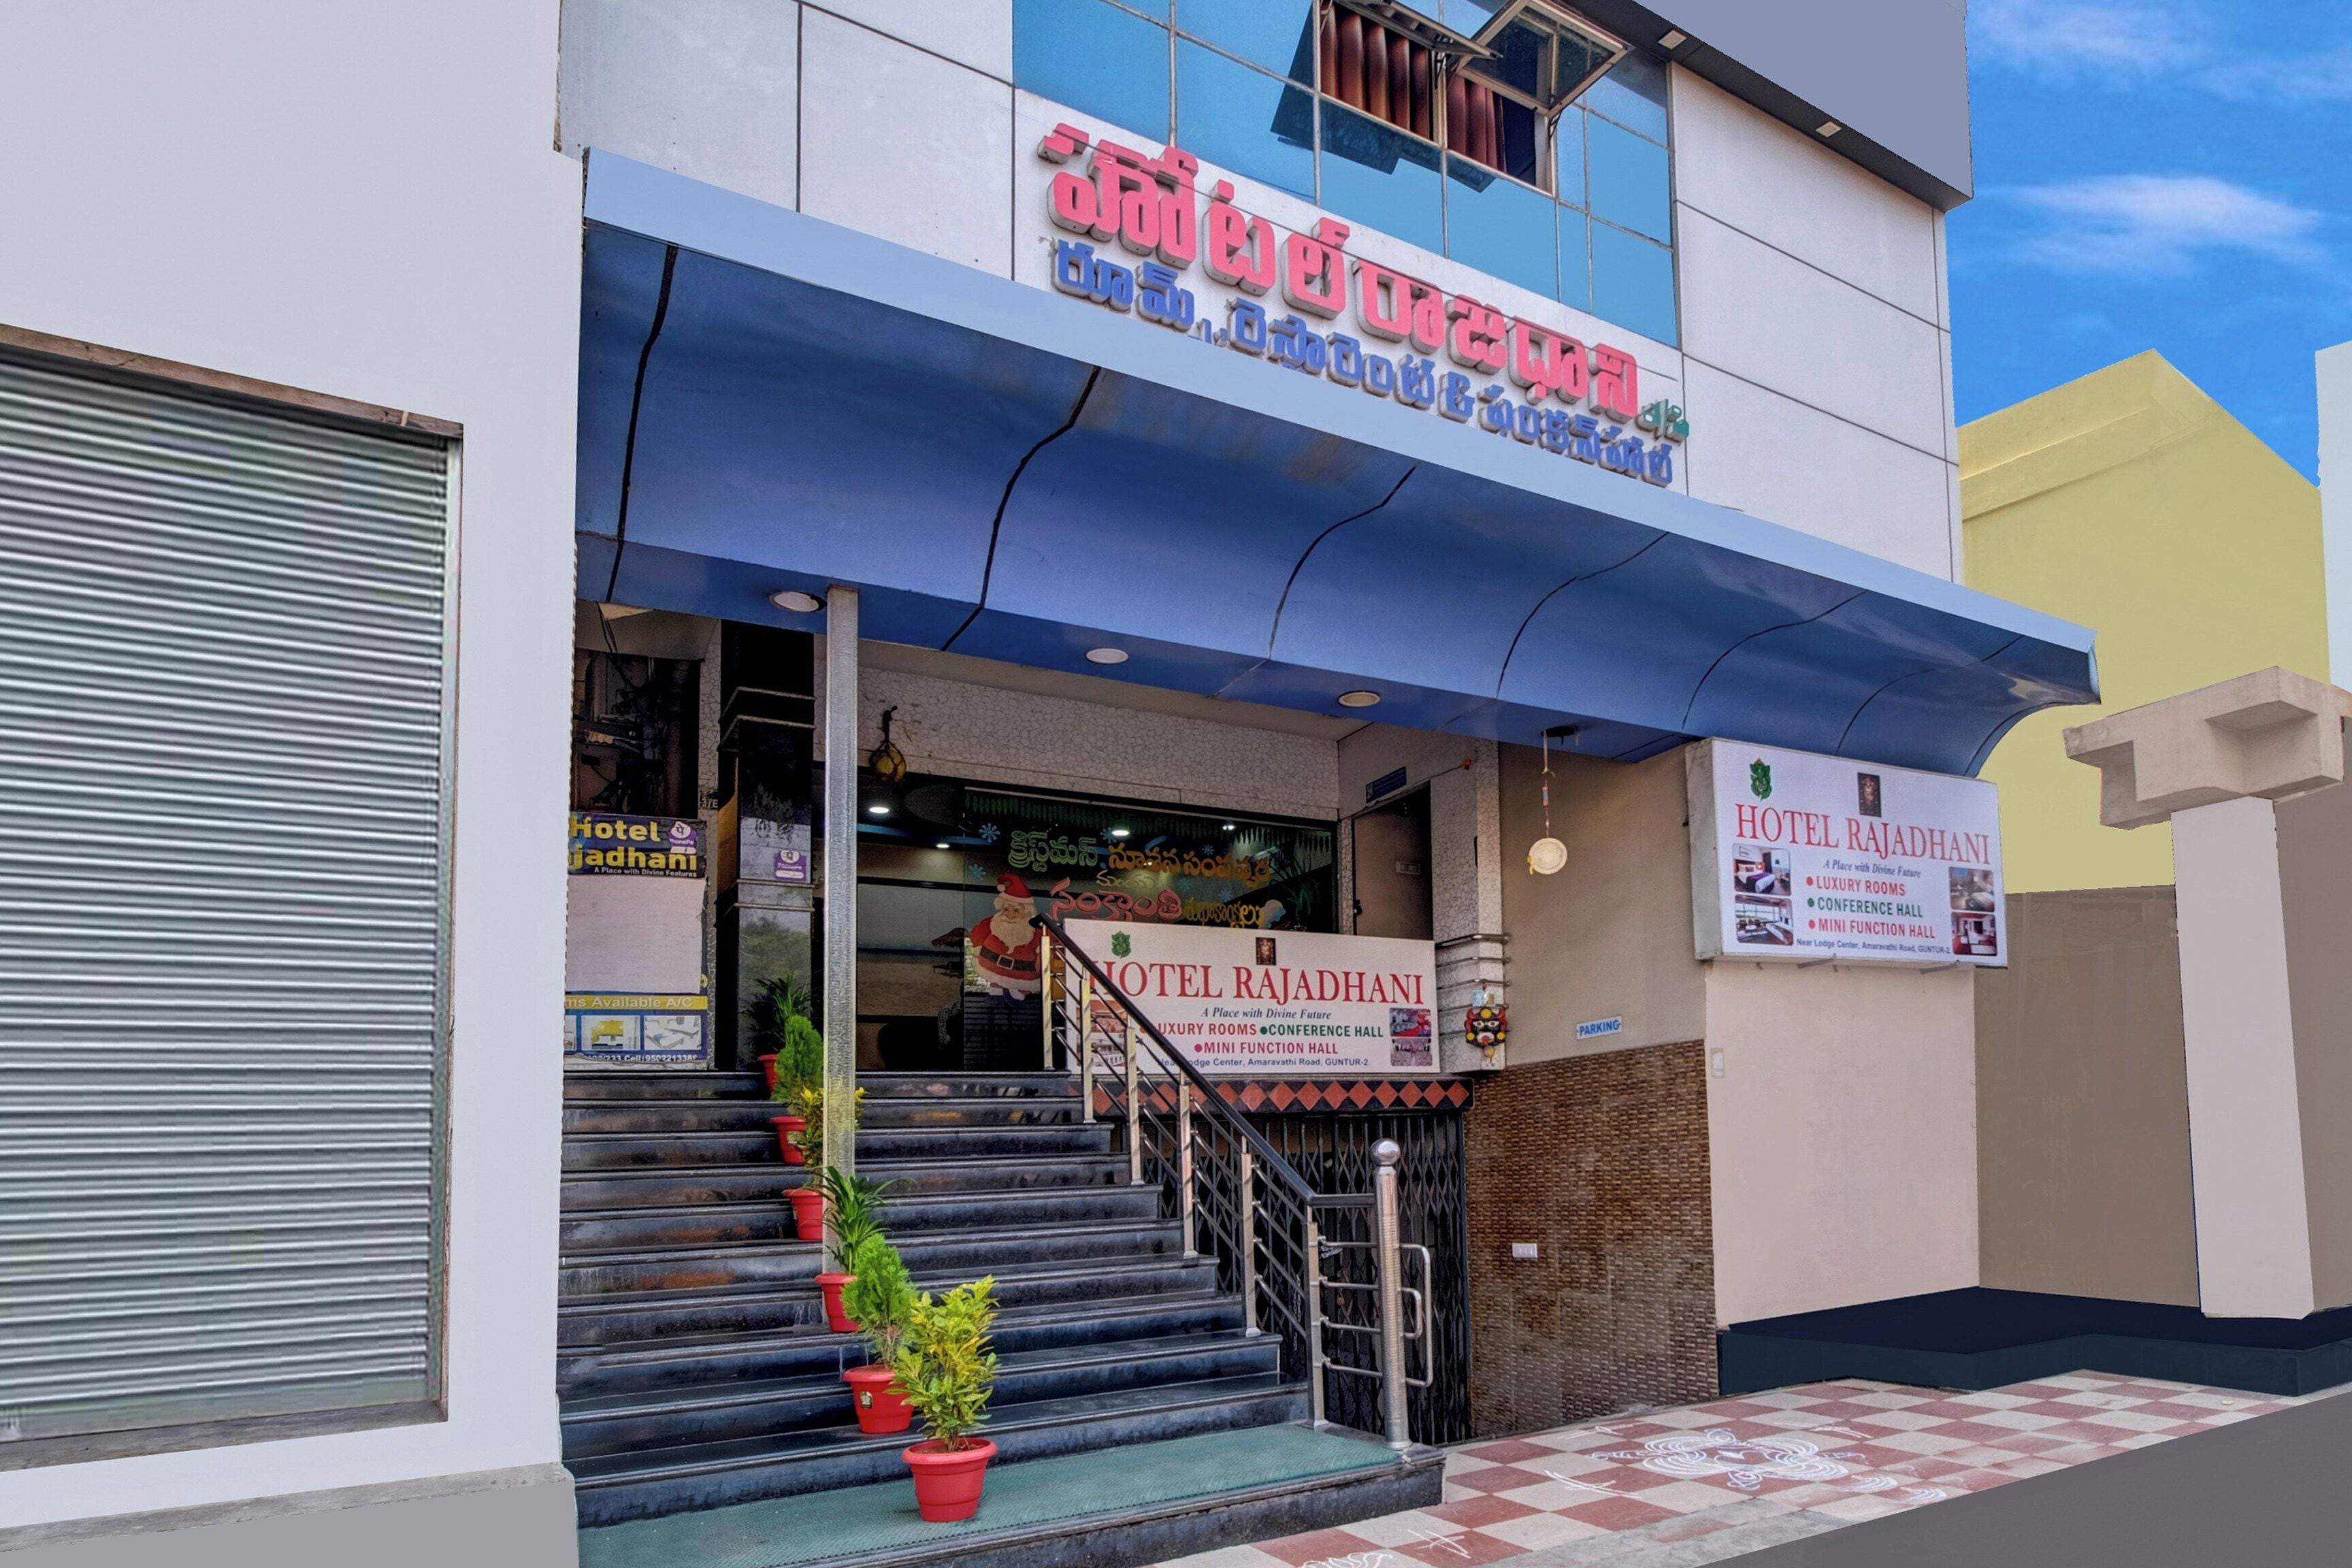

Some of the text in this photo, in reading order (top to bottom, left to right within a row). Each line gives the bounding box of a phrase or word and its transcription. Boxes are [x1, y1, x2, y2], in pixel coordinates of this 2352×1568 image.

[1735, 804, 1991, 864] HOTEL RAJADHANI
[1824, 859, 1921, 878] A Place with Divine Future
[1816, 876, 1906, 896] LUXURY ROOMS
[1818, 897, 1923, 917] CONFERENCE HALL
[1818, 918, 1935, 938] MINI FUNCTION HALL
[1797, 938, 1812, 946] Near
[1814, 938, 1835, 948] Lodge
[1862, 943, 1897, 951] Amaravathi
[1232, 966, 1424, 1005] RAJADHANI
[593, 997, 661, 1007] Available
[666, 997, 692, 1007] A/C
[1200, 1007, 1332, 1020] A Place with Divine Future
[1209, 1024, 1256, 1036] ROOMS
[1269, 1024, 1350, 1036] CONFERENCE
[1354, 1026, 1384, 1037] HALL
[1580, 1019, 1619, 1036] PARKING
[1204, 1043, 1339, 1054] MINI FUNCTION HALL
[1213, 1059, 1245, 1067] Center,
[1247, 1058, 1296, 1066] Amaravathi
[1298, 1059, 1322, 1067] Road,
